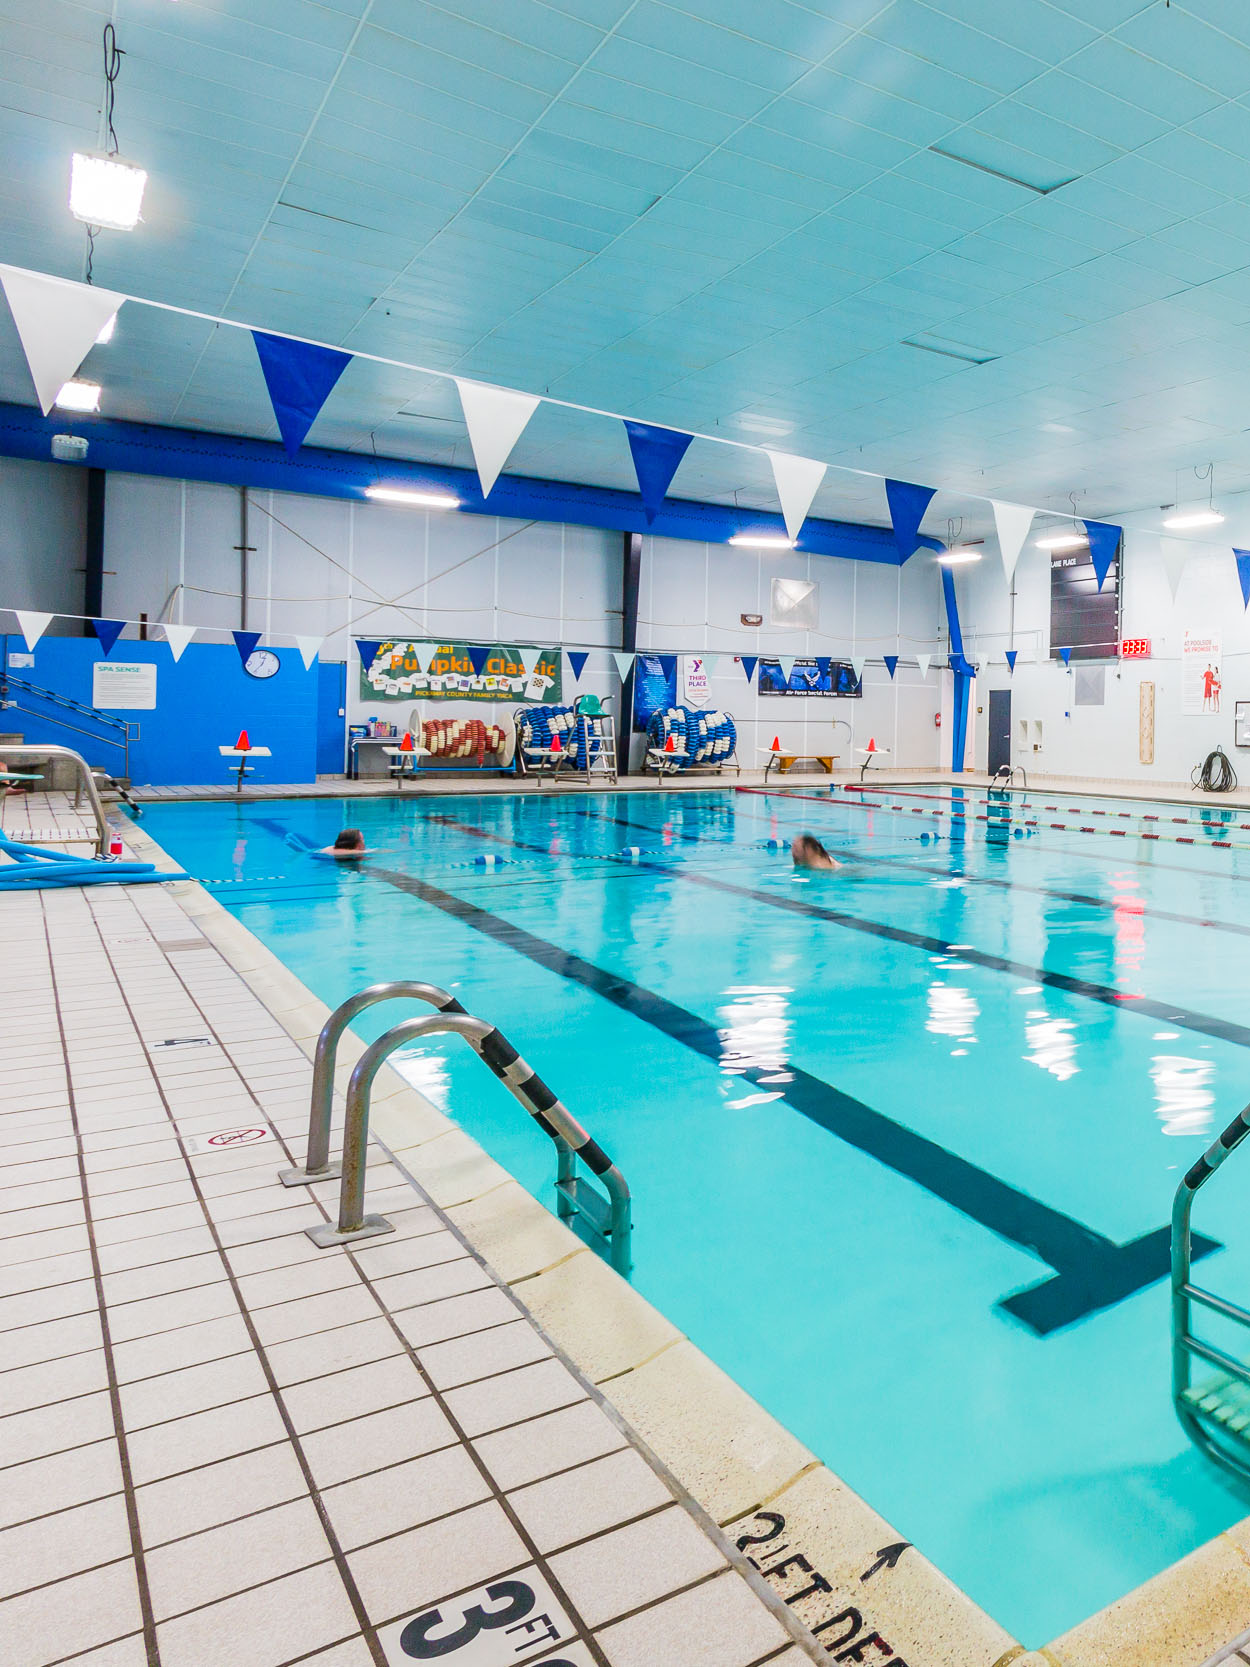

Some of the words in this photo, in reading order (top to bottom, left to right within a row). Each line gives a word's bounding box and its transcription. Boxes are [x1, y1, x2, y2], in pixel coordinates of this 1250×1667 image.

[1063, 558, 1077, 567] PLACE
[400, 1580, 537, 1660] 3
[504, 1613, 562, 1653] FT
[761, 1553, 834, 1606] FT
[810, 1606, 911, 1667] DE
